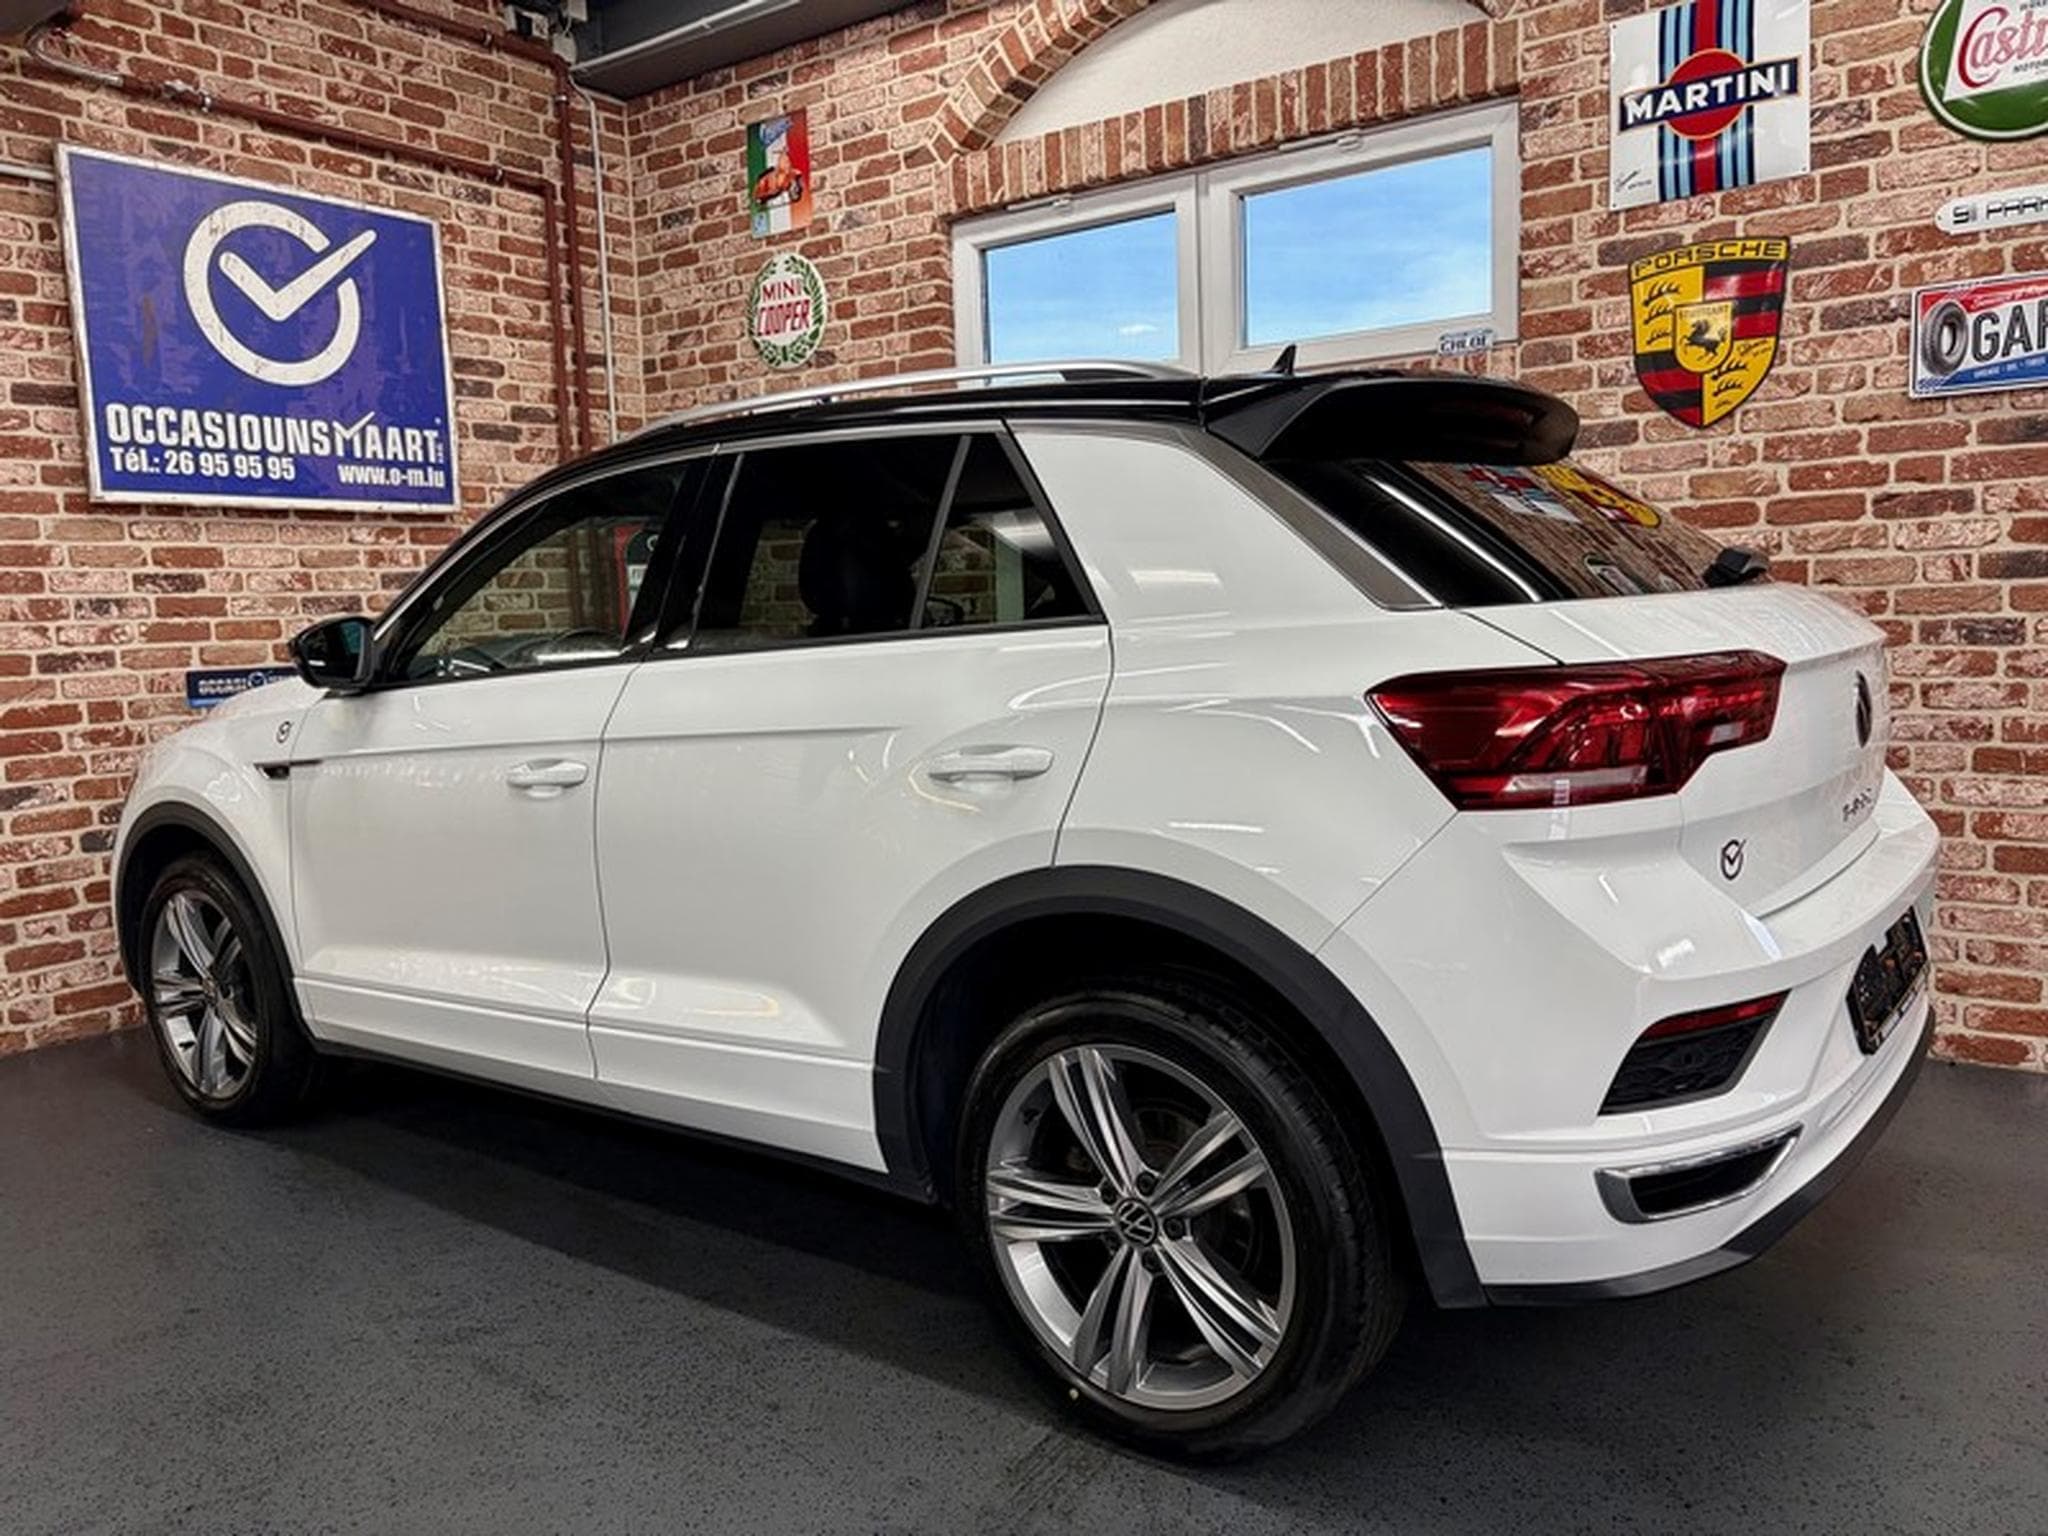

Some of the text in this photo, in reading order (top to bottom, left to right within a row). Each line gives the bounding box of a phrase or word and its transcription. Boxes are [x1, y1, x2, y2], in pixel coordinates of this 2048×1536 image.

[1623, 64, 1790, 125] MARTINI
[1635, 241, 1784, 277] PORSCHE
[762, 278, 801, 303] MINI
[756, 299, 810, 336] COOPER
[110, 446, 295, 481] Tél.: 26 95 95 95
[337, 464, 445, 488] www.o-m.lu
